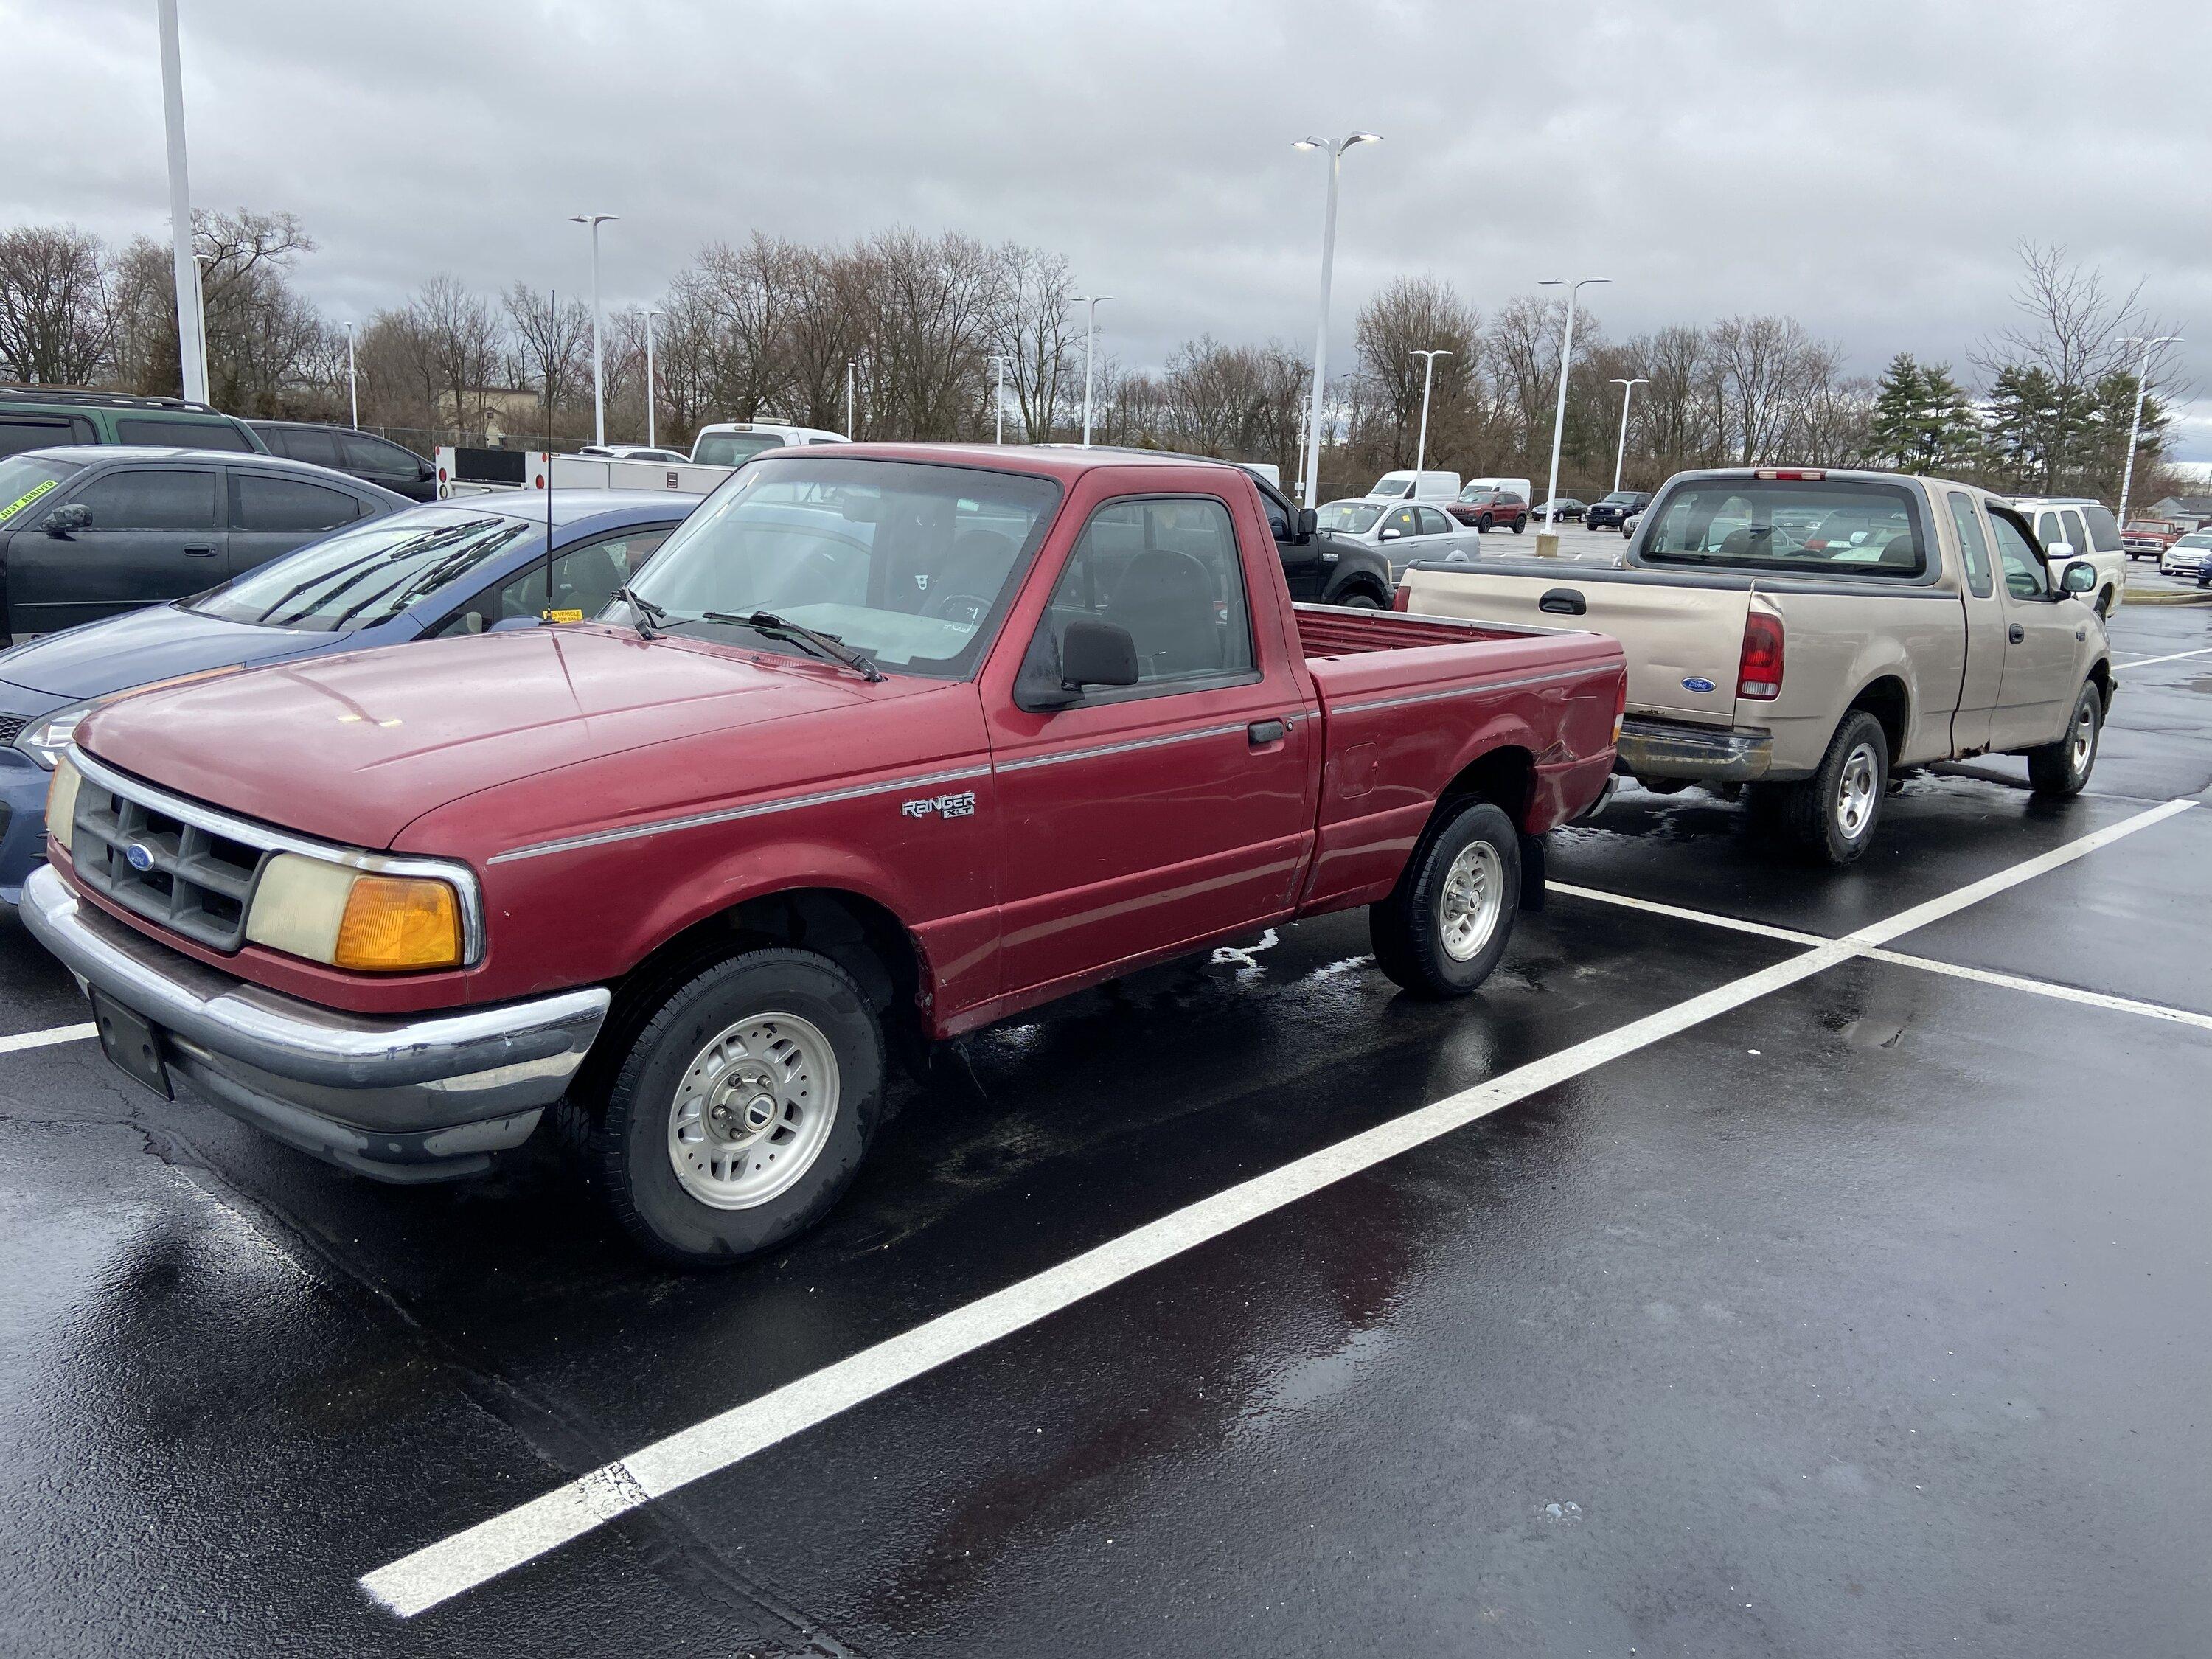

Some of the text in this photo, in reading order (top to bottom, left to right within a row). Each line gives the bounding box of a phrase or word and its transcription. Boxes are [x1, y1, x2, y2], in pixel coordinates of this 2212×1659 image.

[1, 481, 54, 518] JUST ARRIVED
[902, 792, 975, 818] RANGER
[947, 807, 971, 816] XLT
